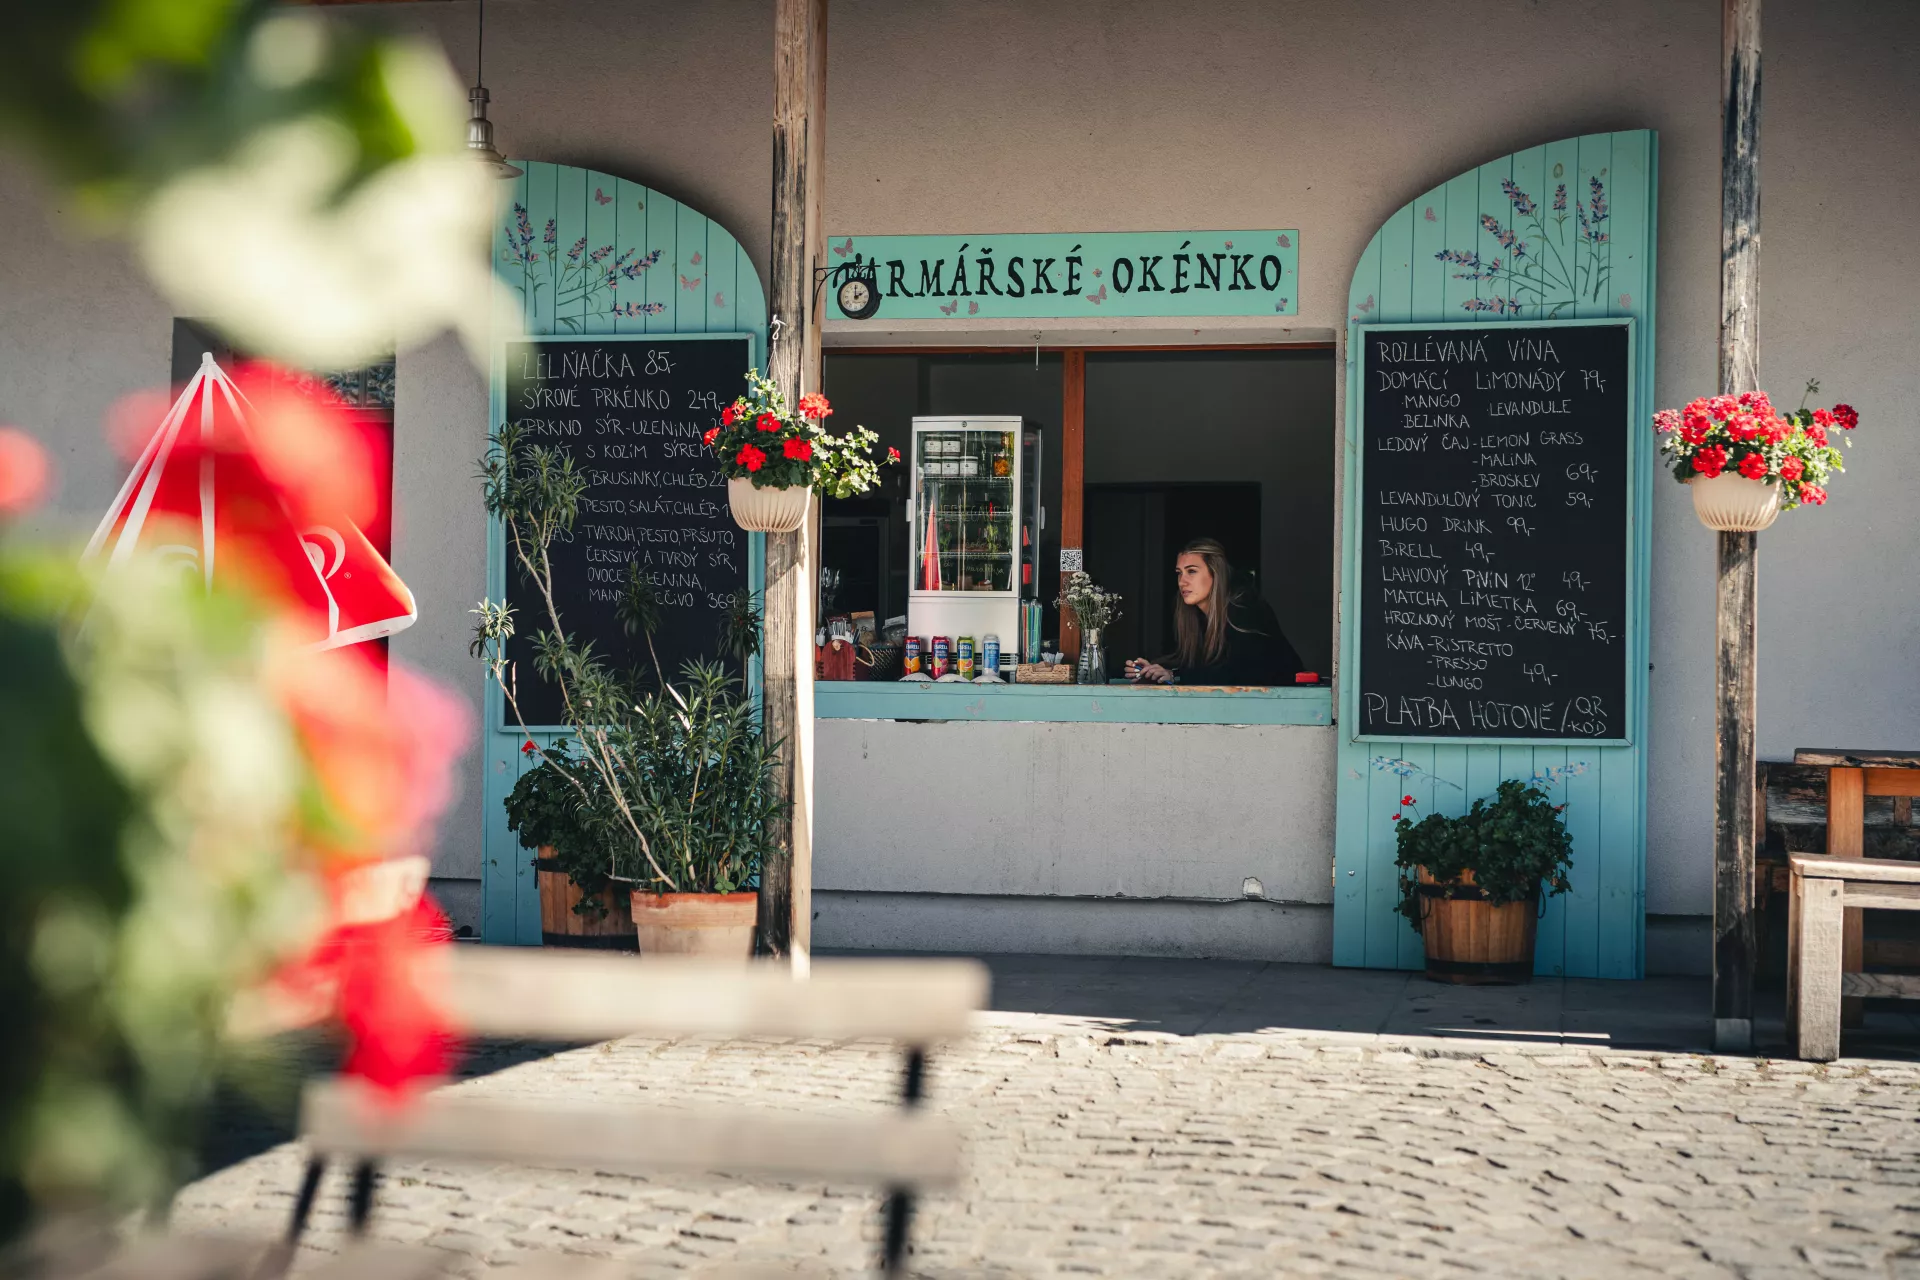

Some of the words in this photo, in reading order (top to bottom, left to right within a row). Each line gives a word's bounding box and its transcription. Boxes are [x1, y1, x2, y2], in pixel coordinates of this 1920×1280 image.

[1112, 240, 1282, 294] OKÉNKO
[1376, 334, 1489, 364] ROZLÉVANÁ
[644, 349, 677, 376] 85,-
[523, 383, 581, 410] SÝROVÉ
[591, 385, 670, 410] PRKÉNKO
[1404, 393, 1461, 409] MANGO
[1489, 399, 1572, 417] LEVANDULE
[523, 418, 582, 437] PRKNO
[586, 444, 596, 459] S
[663, 439, 714, 459] SÝREM
[1378, 432, 1429, 452] LEDOVÝ
[1441, 433, 1470, 451] ČAJ
[1540, 431, 1584, 446] GRASS
[662, 467, 707, 489] CHLÉB
[1380, 487, 1481, 508] LEVANDULOVÝ
[673, 499, 719, 519] CHLÉB
[1380, 515, 1428, 532] HUGO
[586, 545, 639, 564] ČERSTVÝ
[644, 551, 653, 565] A
[658, 546, 699, 568] TVRDÝ
[587, 566, 625, 583] OVOCE
[1382, 564, 1449, 585] LAHVOVÝ
[1383, 588, 1449, 608] MATCHA
[1384, 610, 1456, 630] HROZNOVÝ
[1465, 613, 1503, 632] MOŠT
[1514, 615, 1577, 636] ČERVENÝ
[1386, 629, 1425, 650] KÁVA
[1364, 692, 1461, 730] PLATBA
[1469, 700, 1557, 732] HOTOVĚ
[1575, 695, 1608, 718] QR
